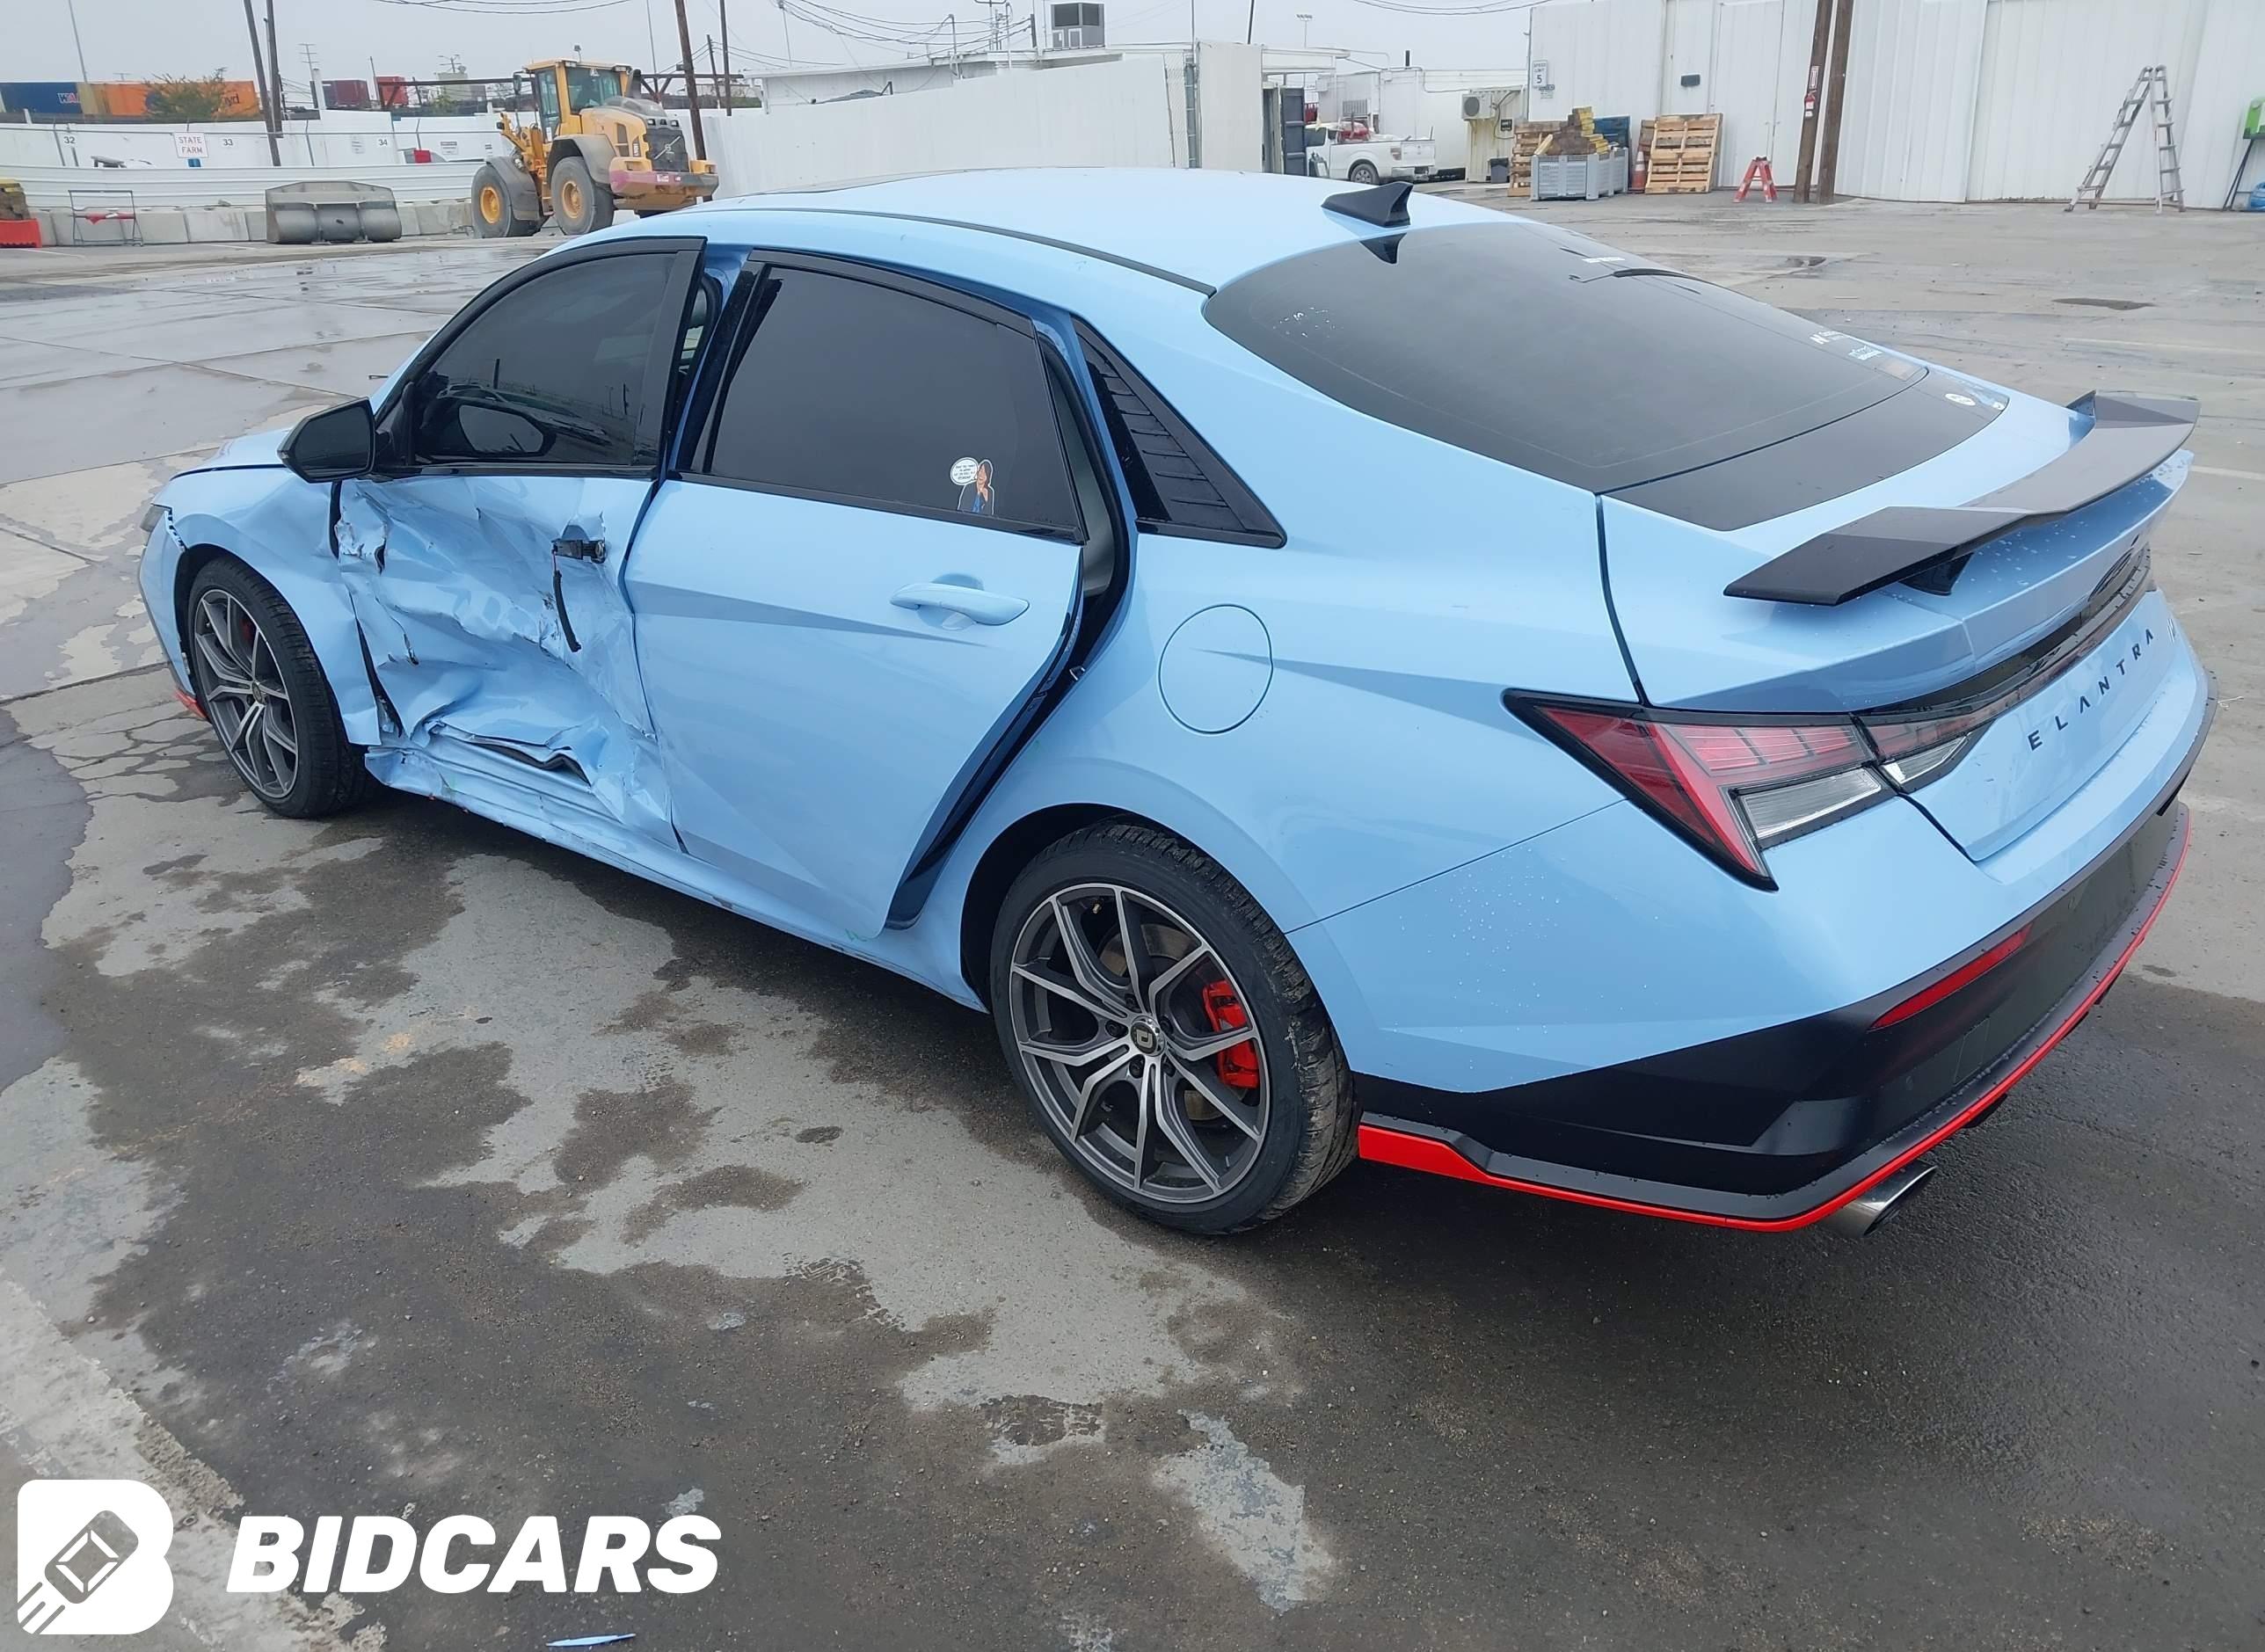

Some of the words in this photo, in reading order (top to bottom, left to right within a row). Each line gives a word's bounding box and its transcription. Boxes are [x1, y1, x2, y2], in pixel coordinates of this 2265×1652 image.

[1536, 75, 1542, 84] 5
[63, 135, 76, 144] 32
[2028, 630, 2153, 751] ELANTRA
